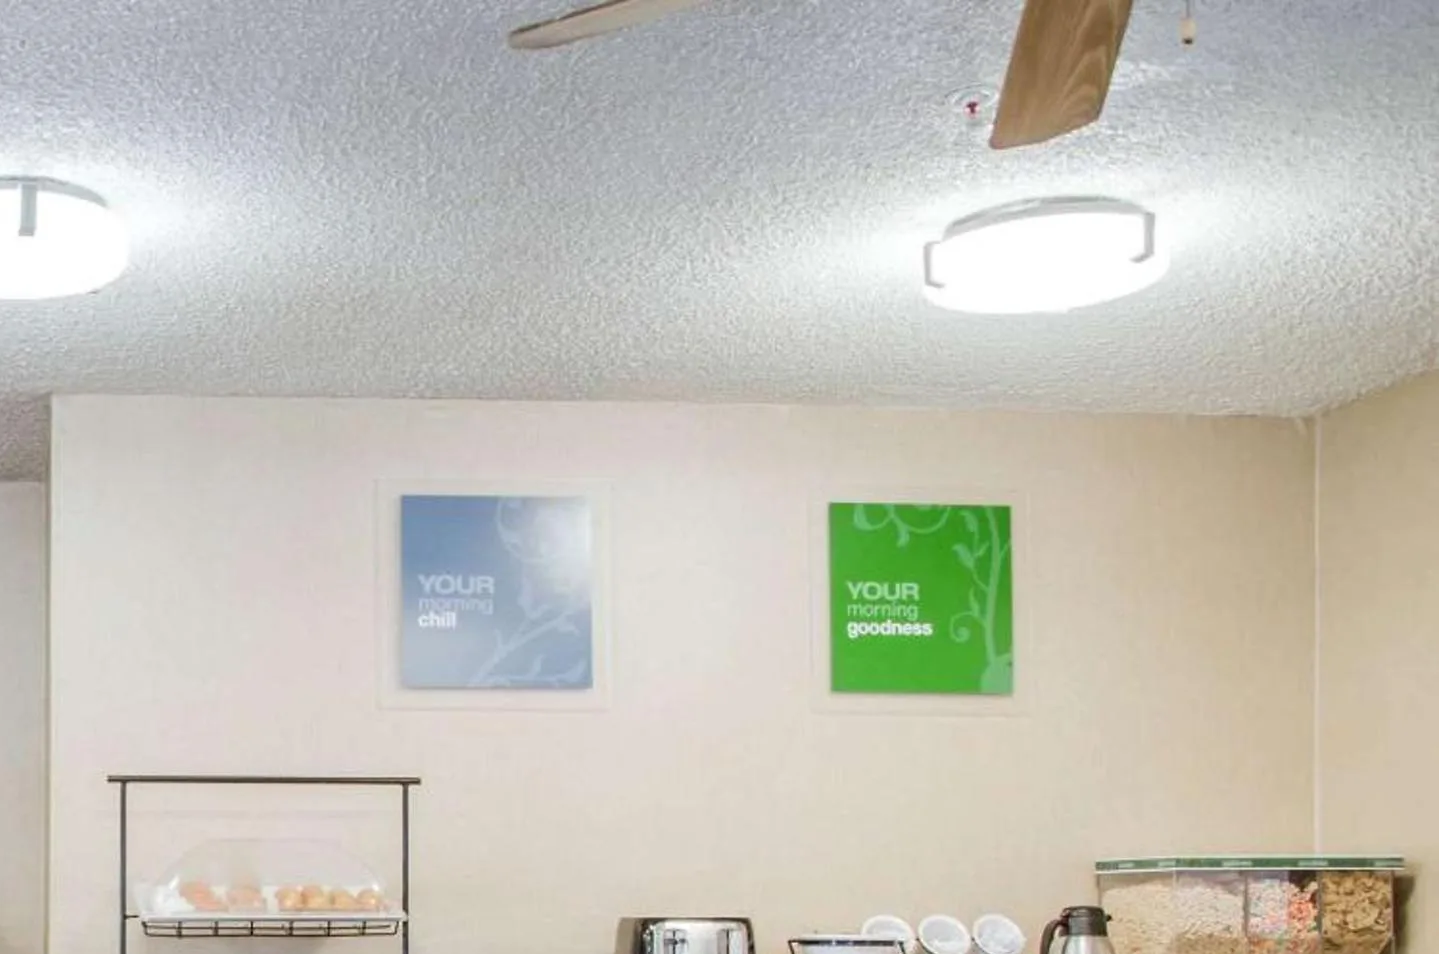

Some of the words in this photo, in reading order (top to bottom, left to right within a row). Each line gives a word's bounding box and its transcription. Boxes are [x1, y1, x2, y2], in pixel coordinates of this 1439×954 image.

[418, 574, 495, 594] YOUR
[846, 581, 920, 600] YOUR
[418, 597, 494, 615] morning
[847, 601, 919, 621] morning
[418, 610, 457, 628] chill
[847, 620, 934, 638] goodness
